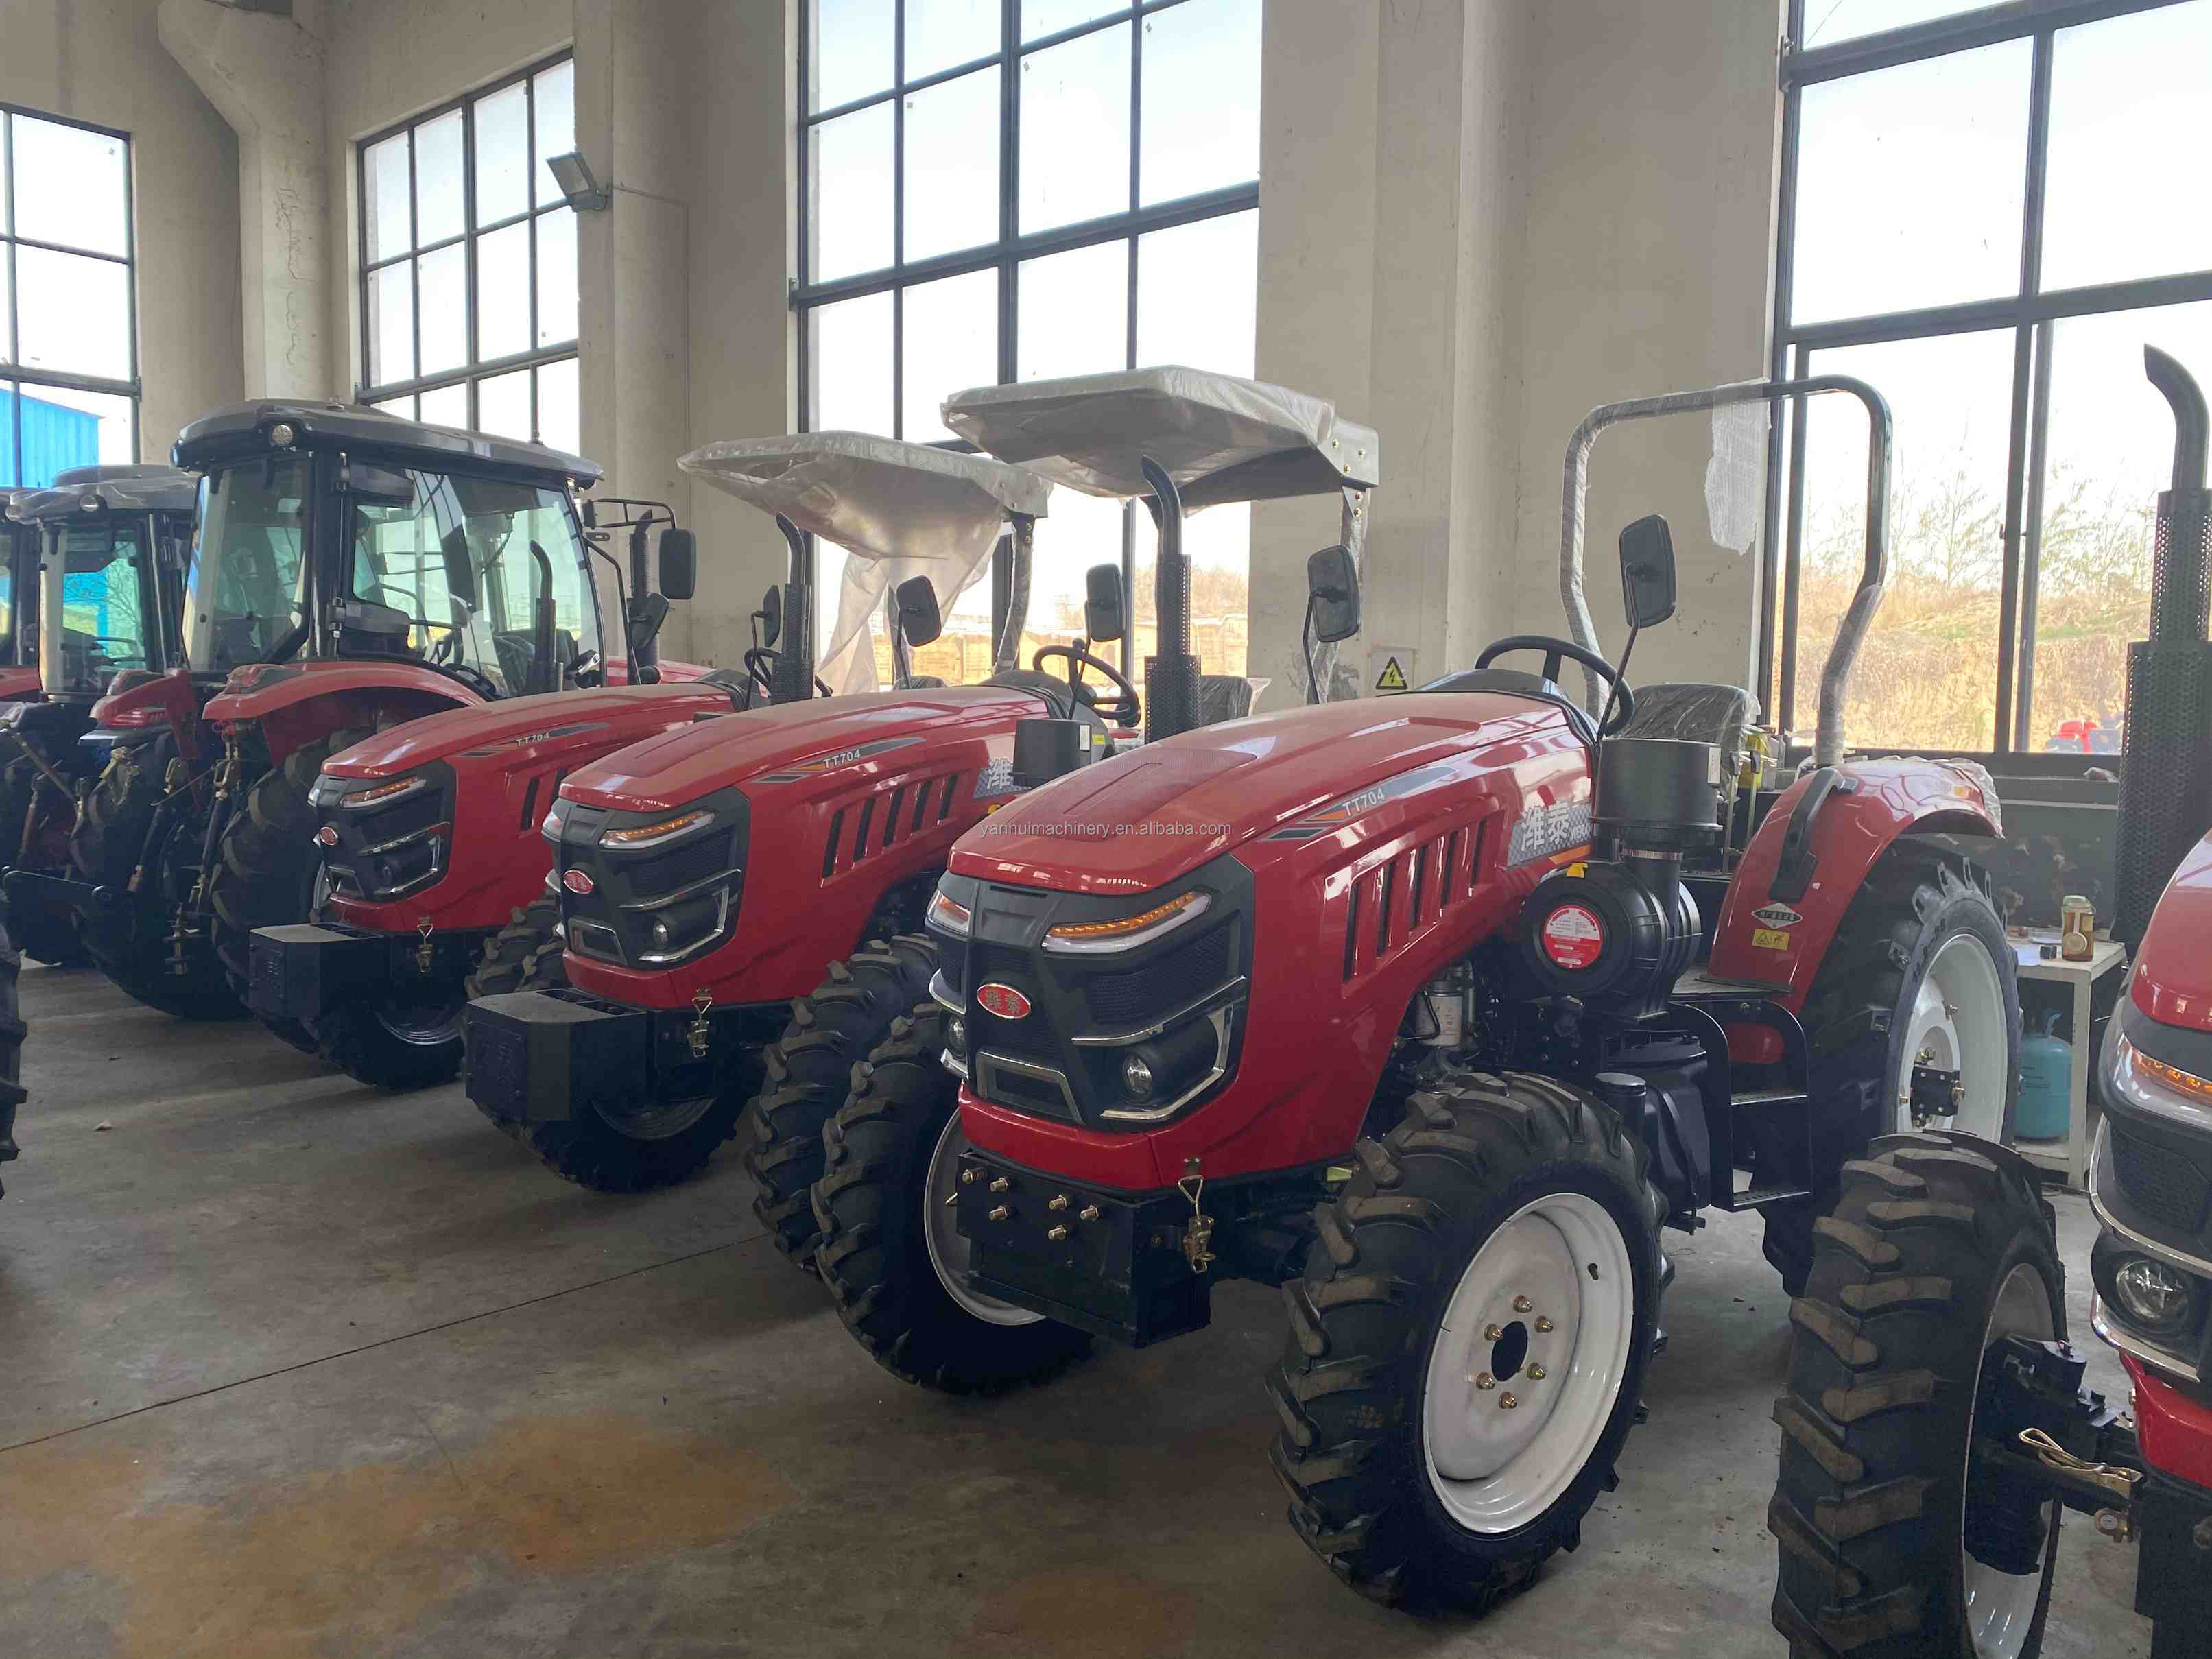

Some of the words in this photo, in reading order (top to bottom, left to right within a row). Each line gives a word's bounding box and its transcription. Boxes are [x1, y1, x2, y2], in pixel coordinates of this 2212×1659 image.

[516, 731, 549, 747] TT704
[823, 748, 861, 769] TT704
[986, 756, 1012, 789] 潍
[1342, 787, 1385, 817] TT704
[1520, 800, 1570, 852] 潍泰
